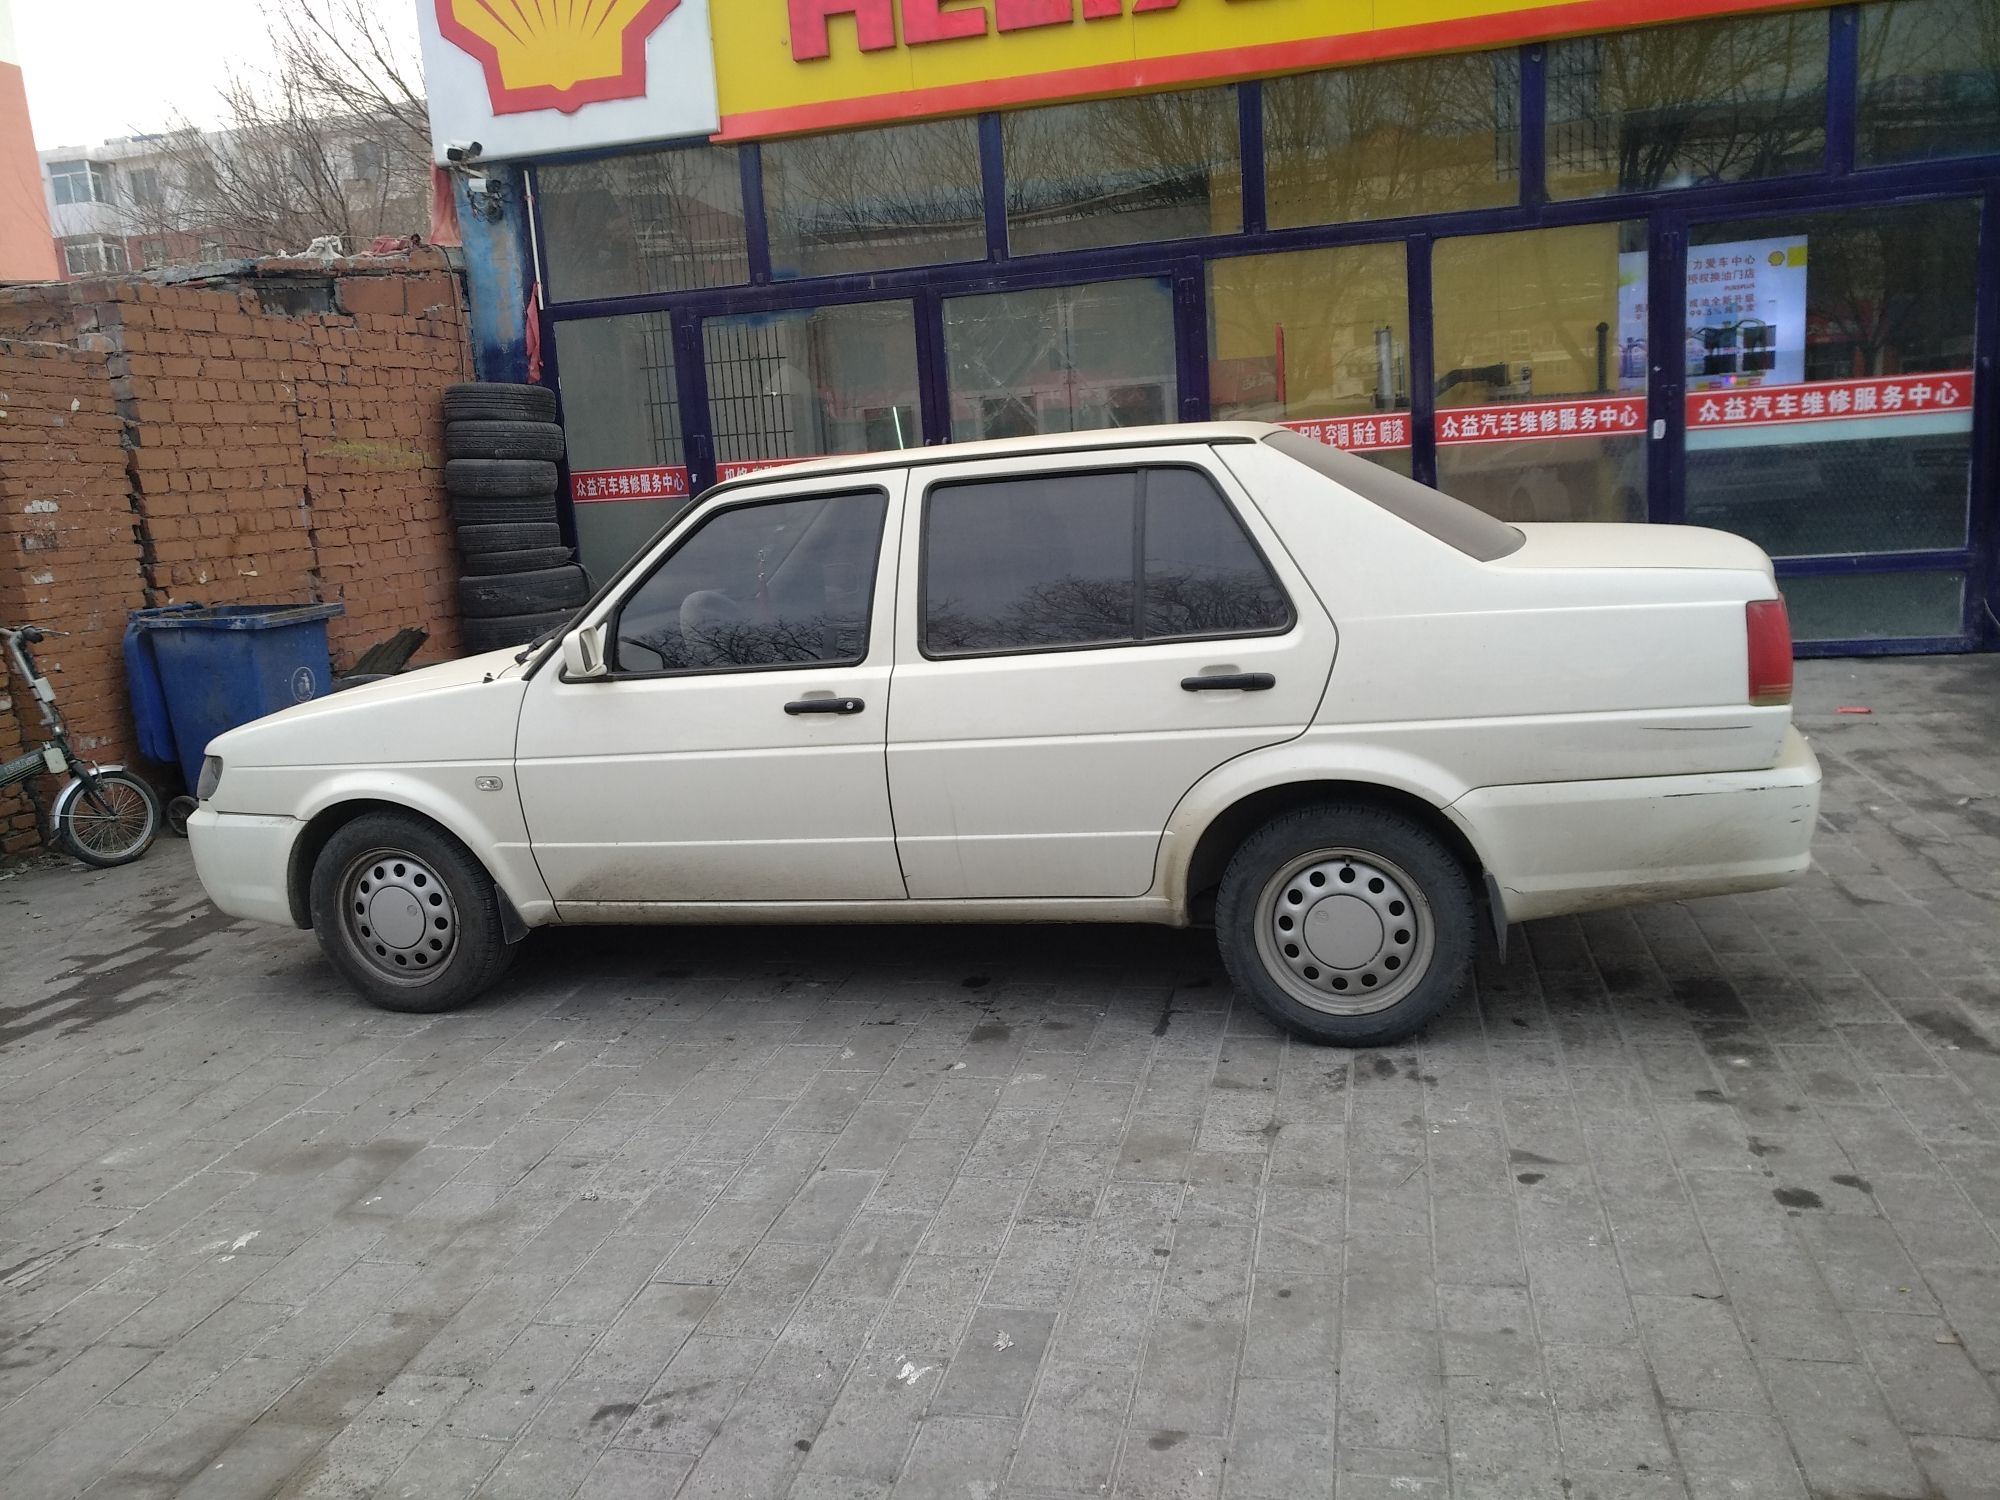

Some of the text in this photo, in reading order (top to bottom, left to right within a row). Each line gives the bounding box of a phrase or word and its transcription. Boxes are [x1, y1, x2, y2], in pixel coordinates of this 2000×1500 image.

[1698, 381, 1960, 422] 众益汽车维修服务中心
[1326, 424, 1349, 447] 空调
[1353, 421, 1376, 445] 钣金
[1380, 418, 1404, 443] 喷漆
[1440, 404, 1638, 438] 众益汽车维修服务中心
[576, 472, 685, 497] 众益汽车维修服务中心
